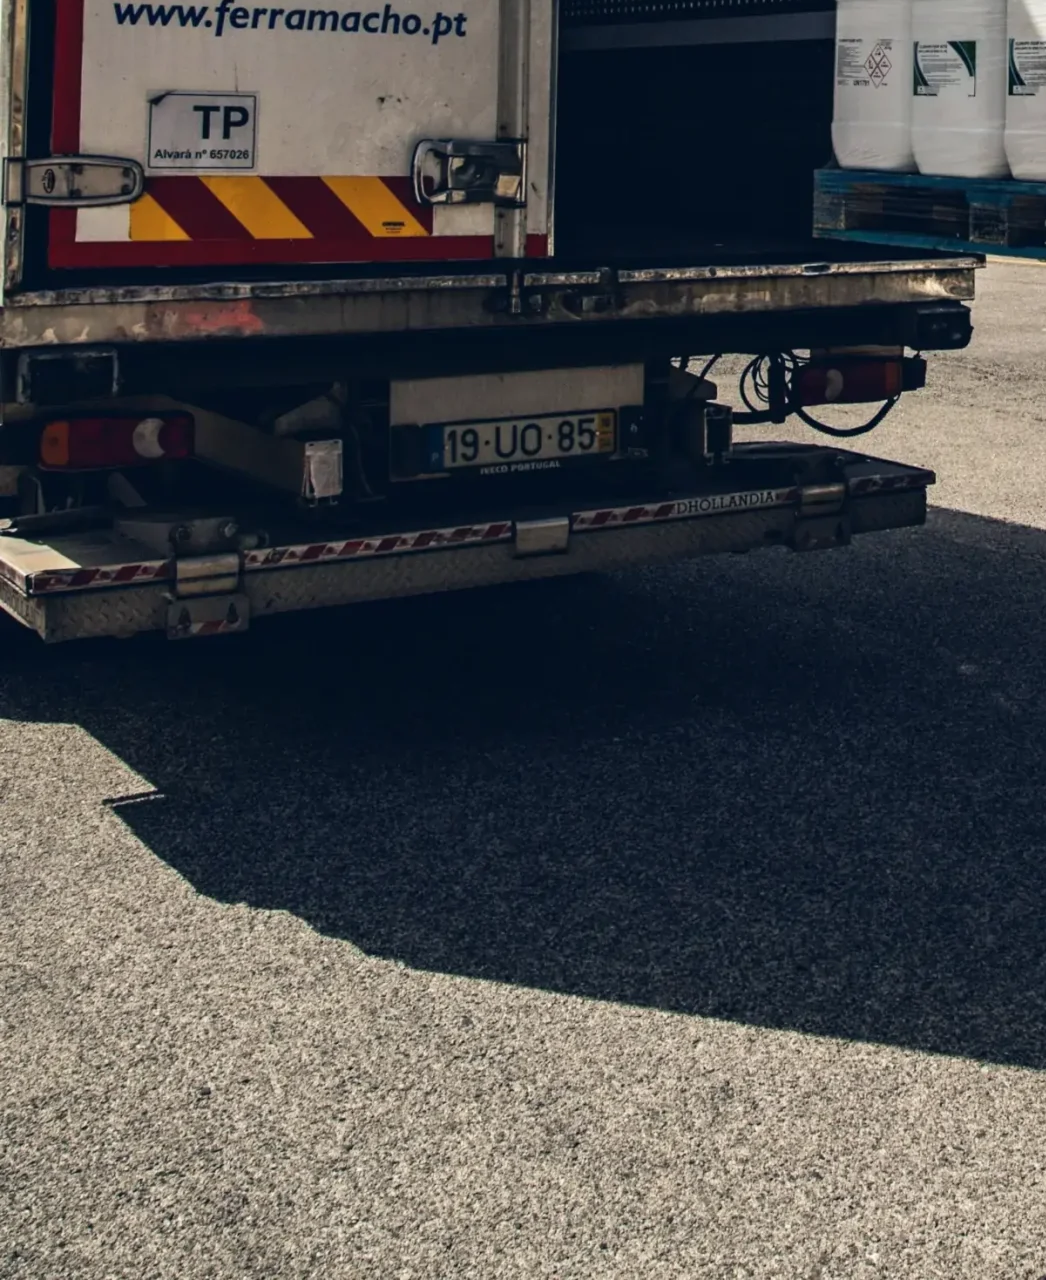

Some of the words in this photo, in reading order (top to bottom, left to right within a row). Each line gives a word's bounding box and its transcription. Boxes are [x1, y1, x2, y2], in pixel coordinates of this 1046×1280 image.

[193, 105, 249, 140] TP
[154, 149, 191, 159] Alvará
[210, 149, 249, 160] 657026
[480, 464, 508, 475] IVECO
[511, 460, 561, 473] PORTUGAL
[677, 491, 775, 515] DHOLLANDIA
